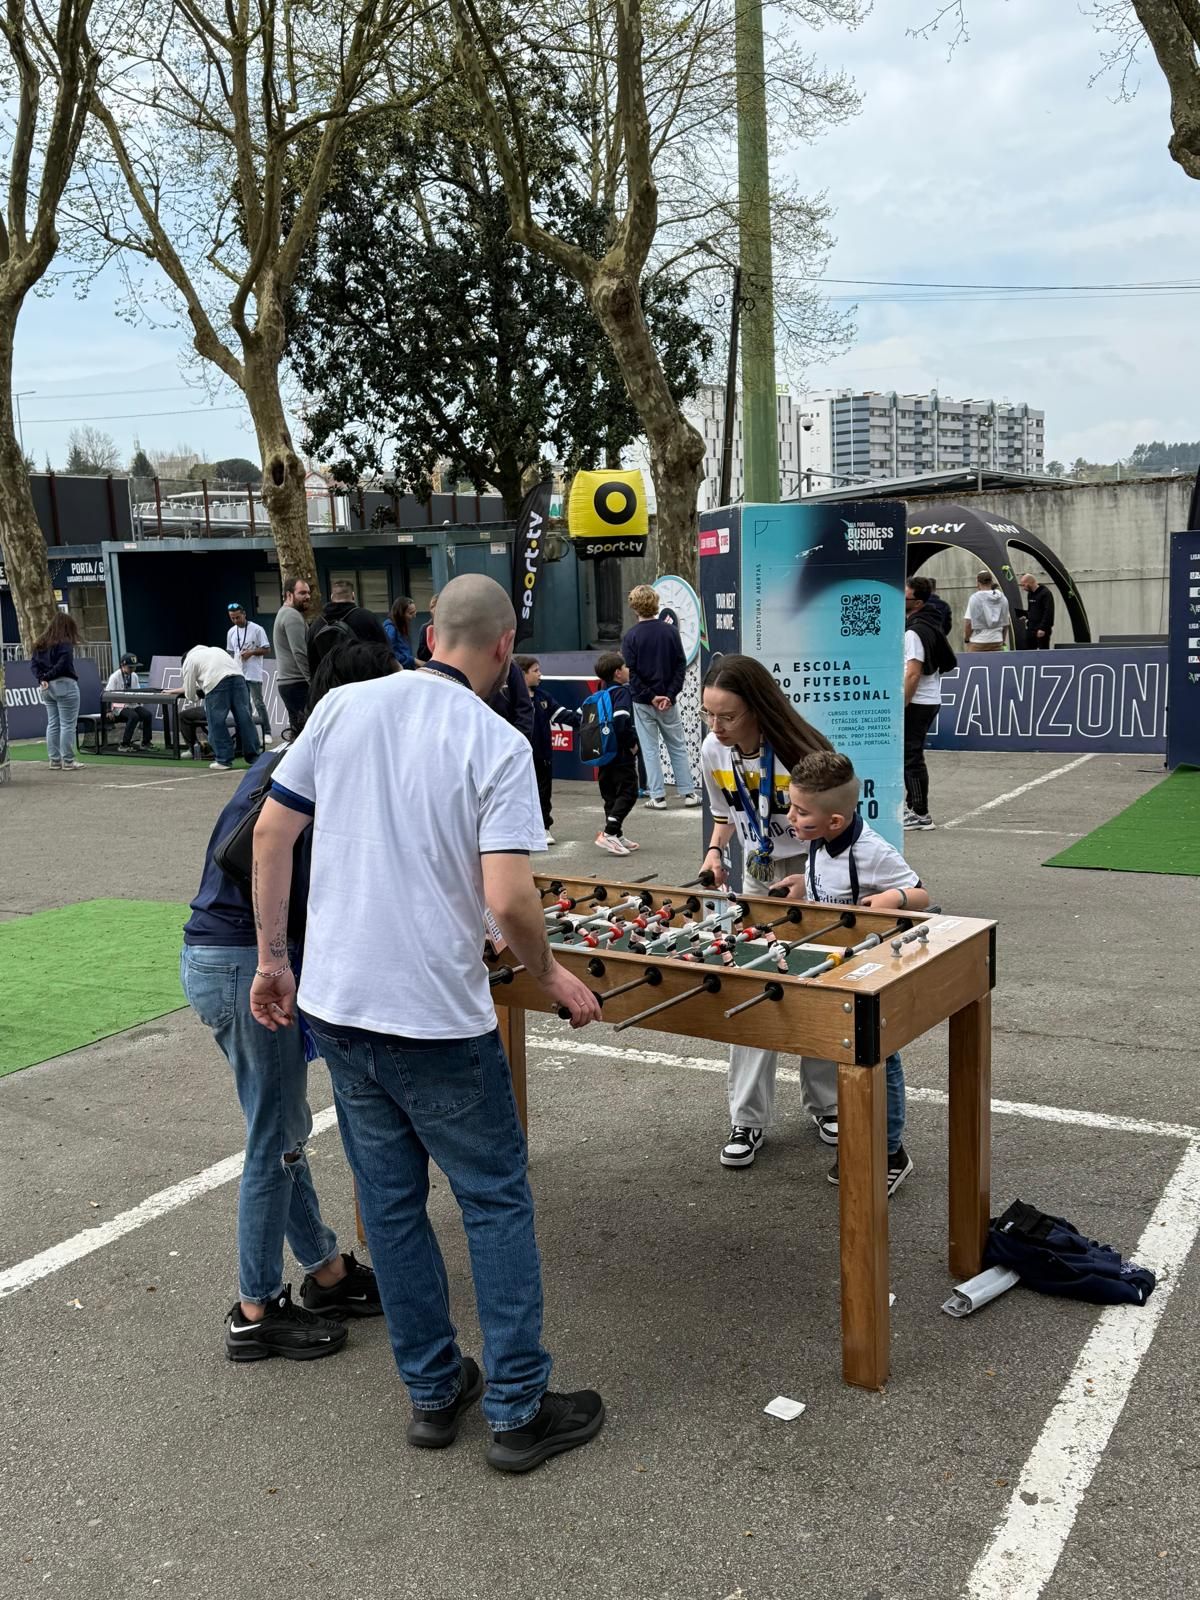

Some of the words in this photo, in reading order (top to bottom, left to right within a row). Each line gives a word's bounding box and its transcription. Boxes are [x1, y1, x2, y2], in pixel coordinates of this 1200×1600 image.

[776, 384, 789, 393] ELS
[847, 527, 894, 539] BUSINESS
[847, 539, 884, 551] SCHOOL
[71, 562, 93, 575] PORTA
[773, 663, 781, 673] A
[793, 660, 851, 672] ESCOLA
[803, 675, 870, 687] FUTEBOL
[5, 687, 45, 707] ORTU
[785, 690, 890, 703] ROFISSIONAL
[926, 664, 1167, 738] FANZON
[851, 708, 891, 716] CERTIFICADOS
[838, 724, 865, 732] FORMAÇÃO
[552, 733, 569, 747] lic
[864, 779, 875, 798] R
[856, 800, 879, 820] TO
